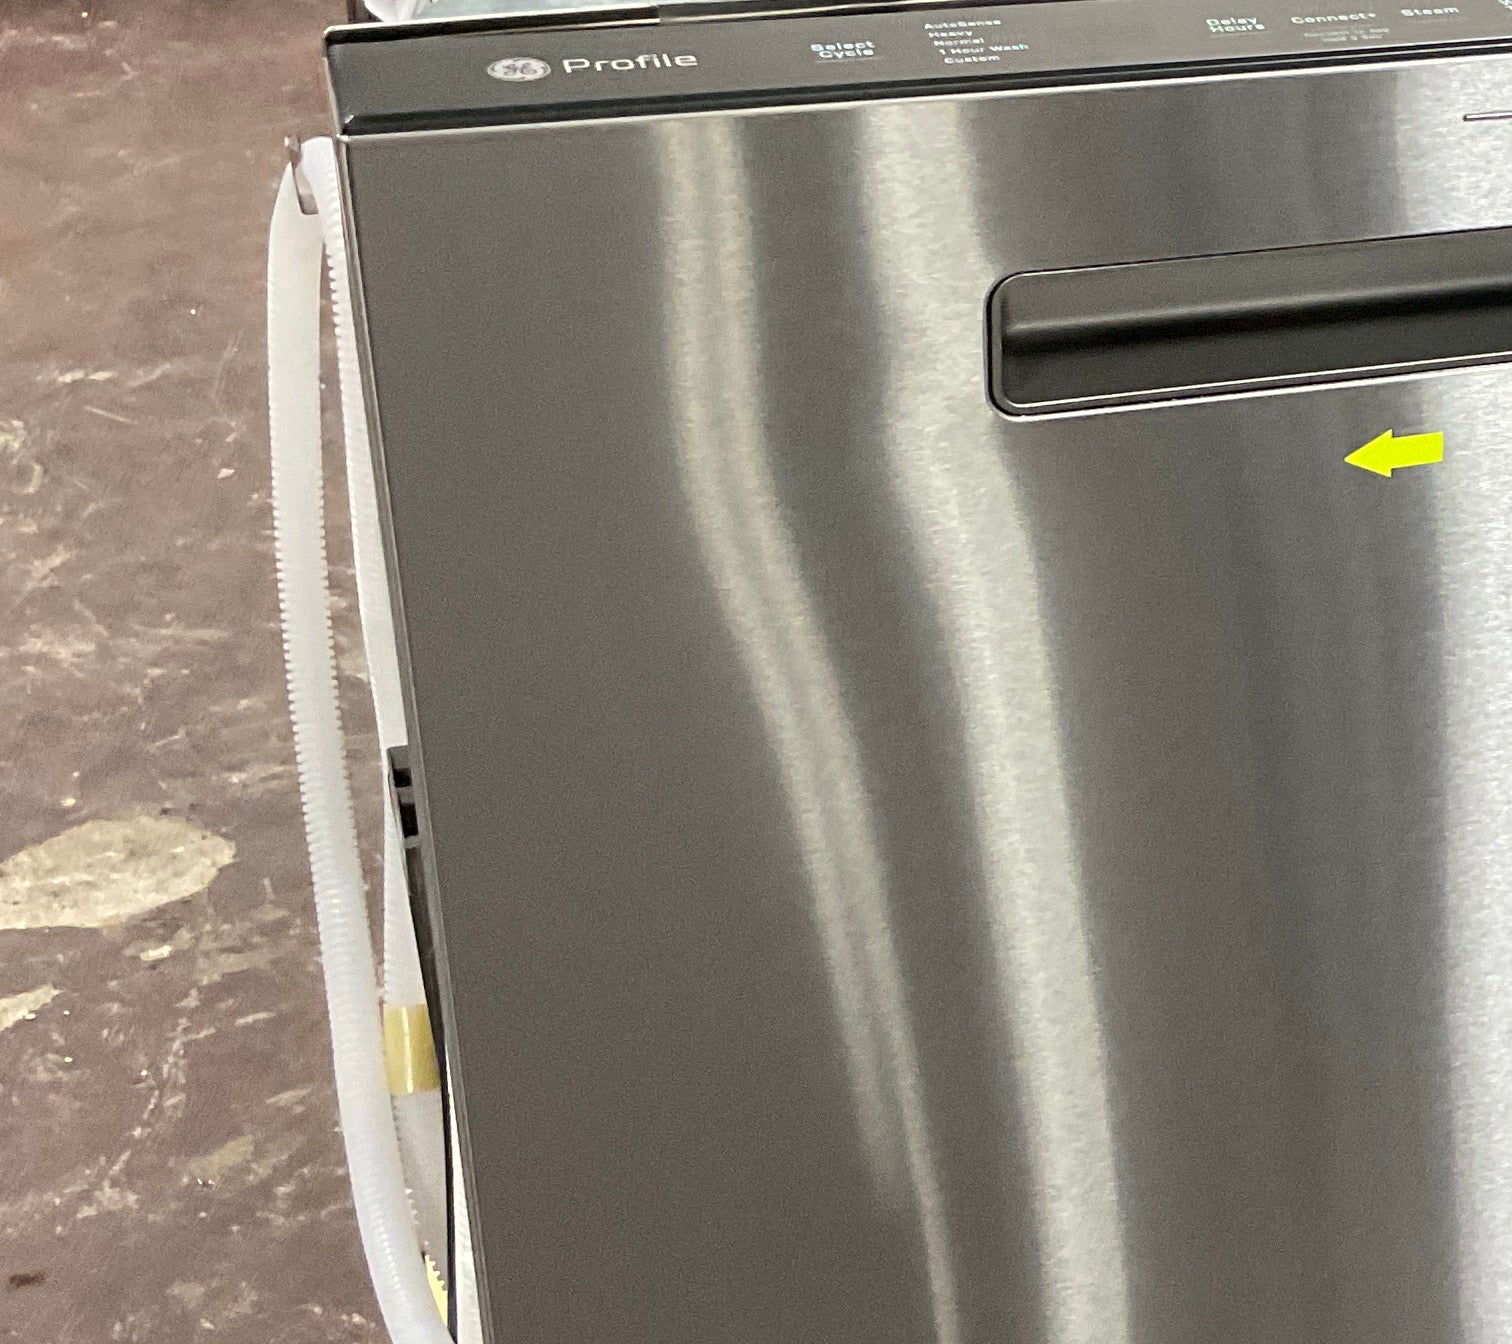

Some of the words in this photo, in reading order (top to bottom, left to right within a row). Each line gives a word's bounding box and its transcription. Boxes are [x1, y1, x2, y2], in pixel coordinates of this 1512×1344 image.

[1400, 6, 1460, 17] Steam
[1206, 17, 1258, 26] Delay
[1291, 12, 1376, 24] Connect+
[1209, 23, 1265, 33] Hours
[810, 40, 876, 52] Select
[818, 48, 875, 60] Cycle
[561, 53, 699, 74] Profile
